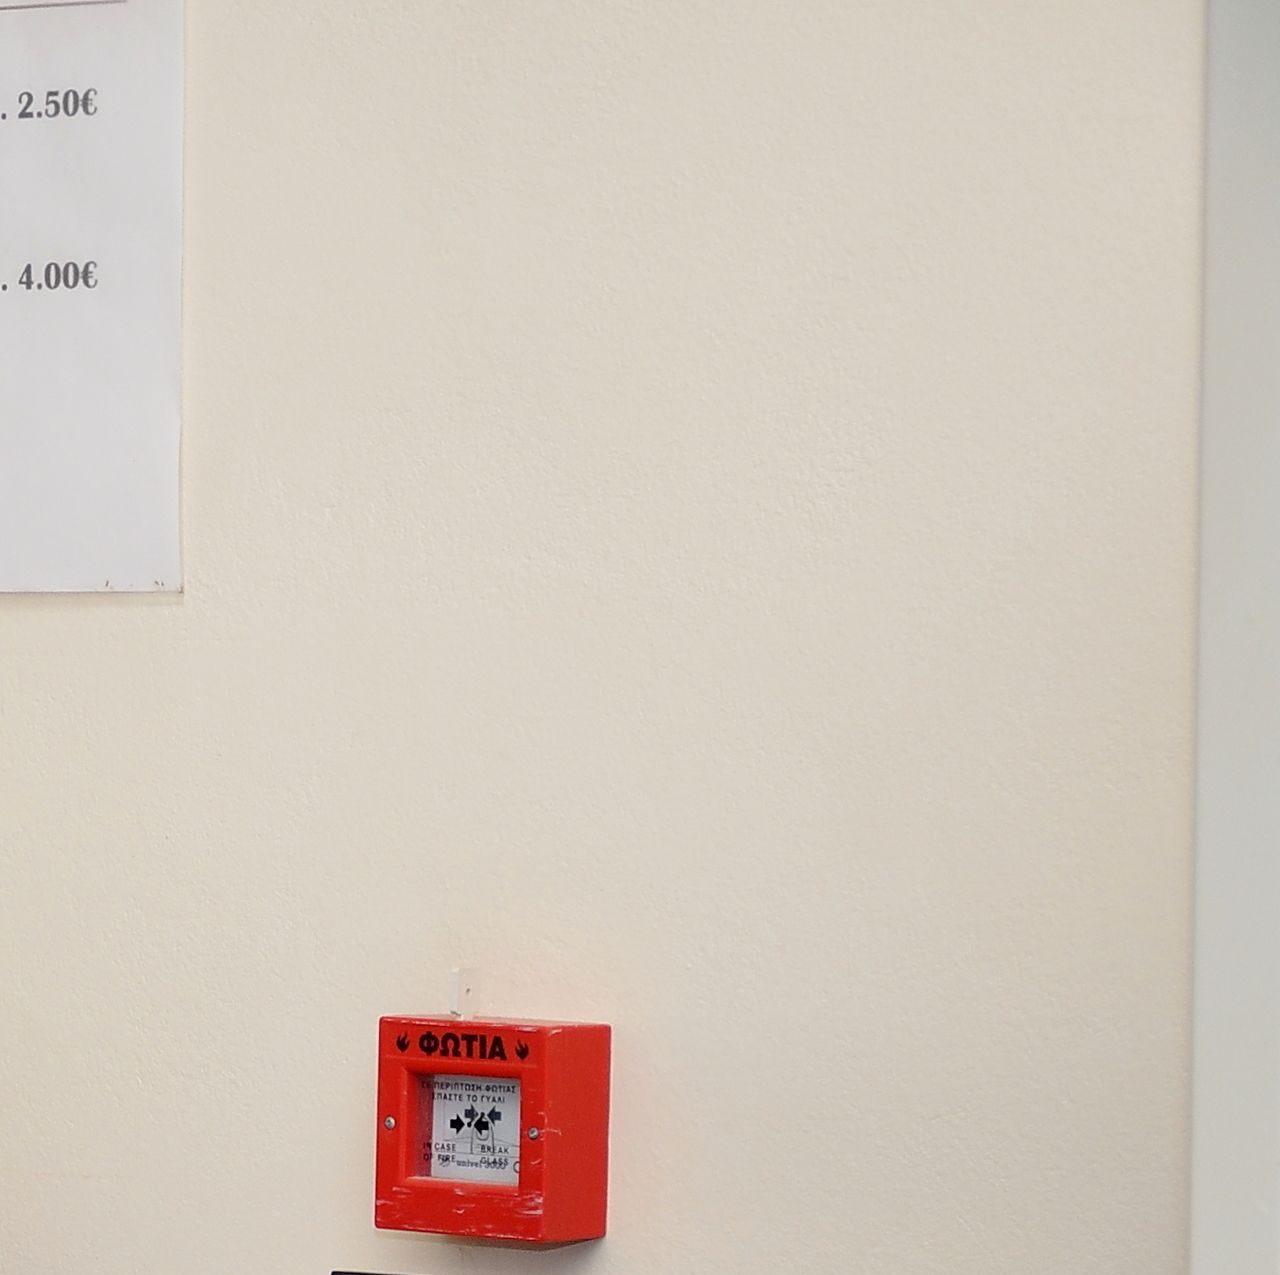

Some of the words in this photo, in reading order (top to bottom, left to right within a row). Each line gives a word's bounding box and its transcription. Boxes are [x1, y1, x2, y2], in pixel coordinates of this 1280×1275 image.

[18, 88, 98, 119] 2.50€
[18, 261, 98, 290] 4.00€
[418, 1031, 507, 1060] ΦΩΤΙΑ
[485, 1084, 516, 1093] ΦΩΤΙΑΣ
[467, 1094, 478, 1102] ΤΟ
[434, 1143, 456, 1152] CASE
[480, 1144, 509, 1154] BREAK
[437, 1154, 456, 1163] FIRE
[481, 1156, 508, 1166] GLASS
